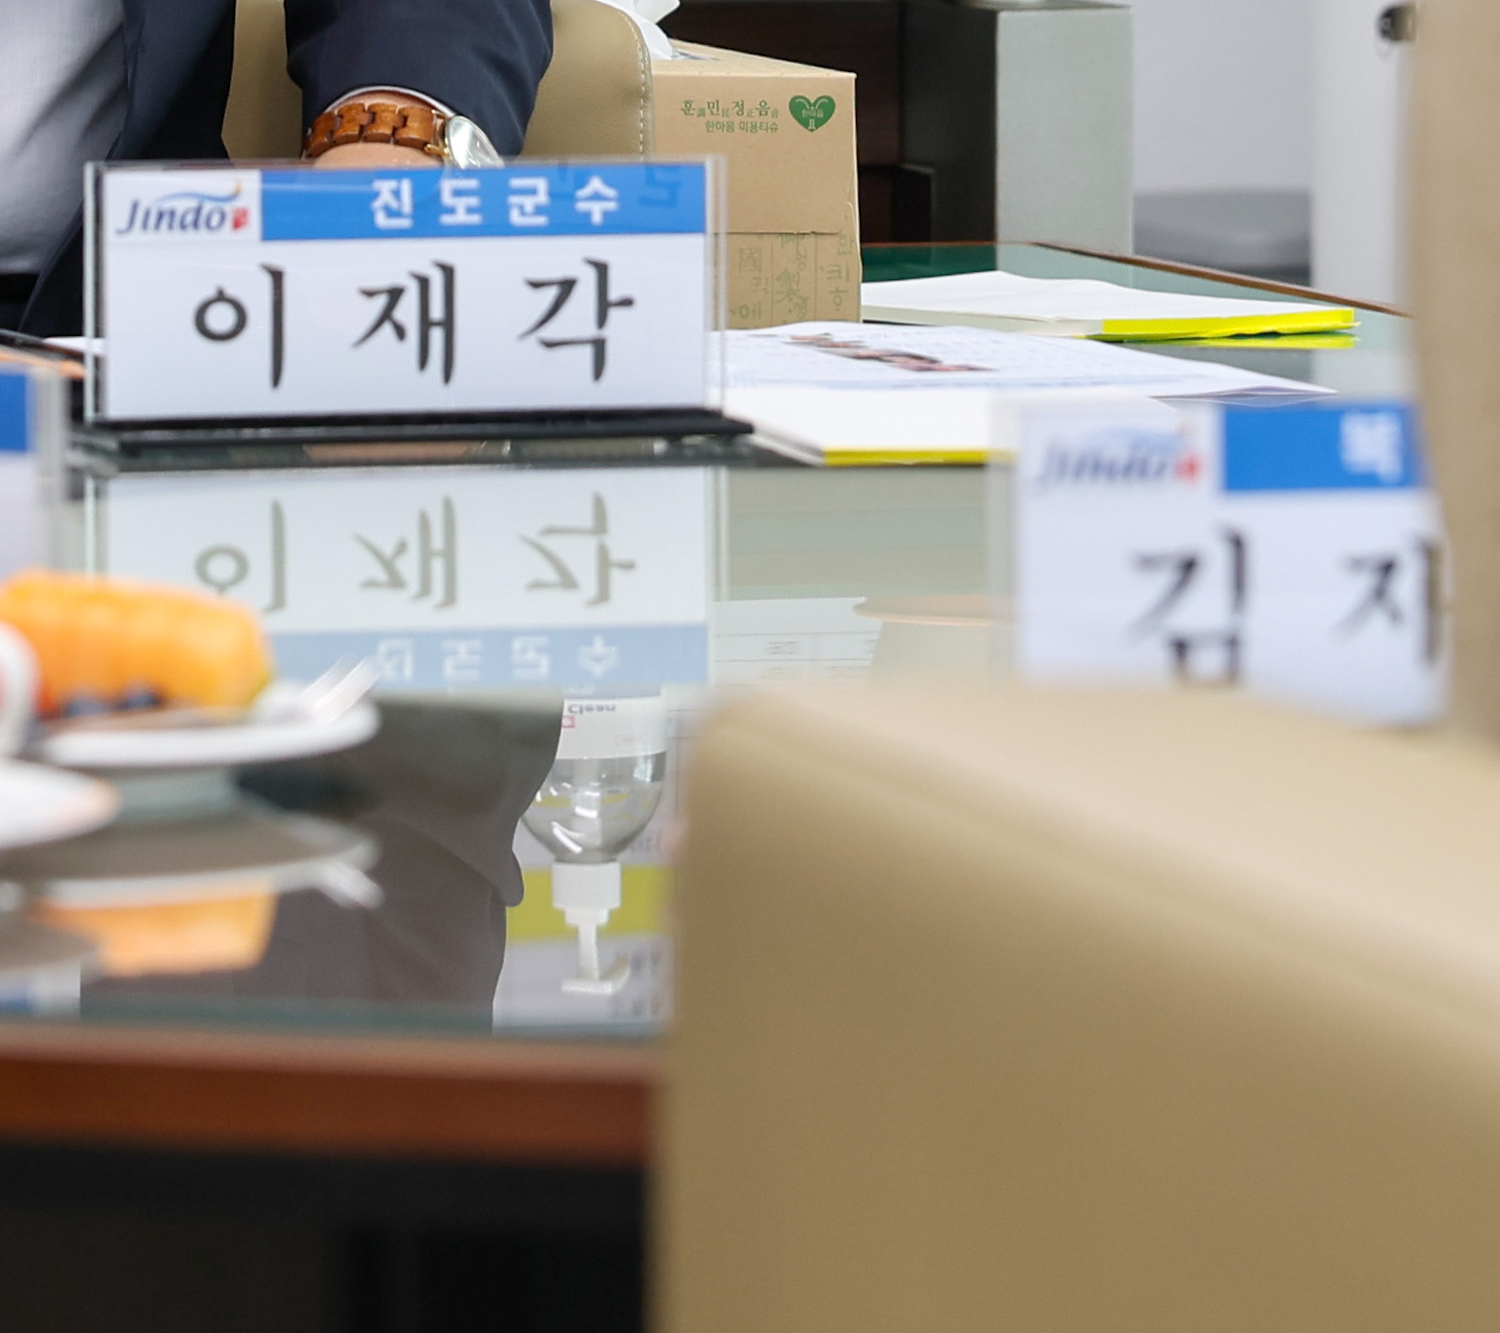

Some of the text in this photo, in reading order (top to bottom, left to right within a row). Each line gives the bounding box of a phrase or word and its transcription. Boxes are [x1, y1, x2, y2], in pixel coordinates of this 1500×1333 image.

[705, 120, 779, 133] 한마음 미용티슈
[369, 177, 620, 230] 진도군수
[193, 257, 636, 389] 이재각
